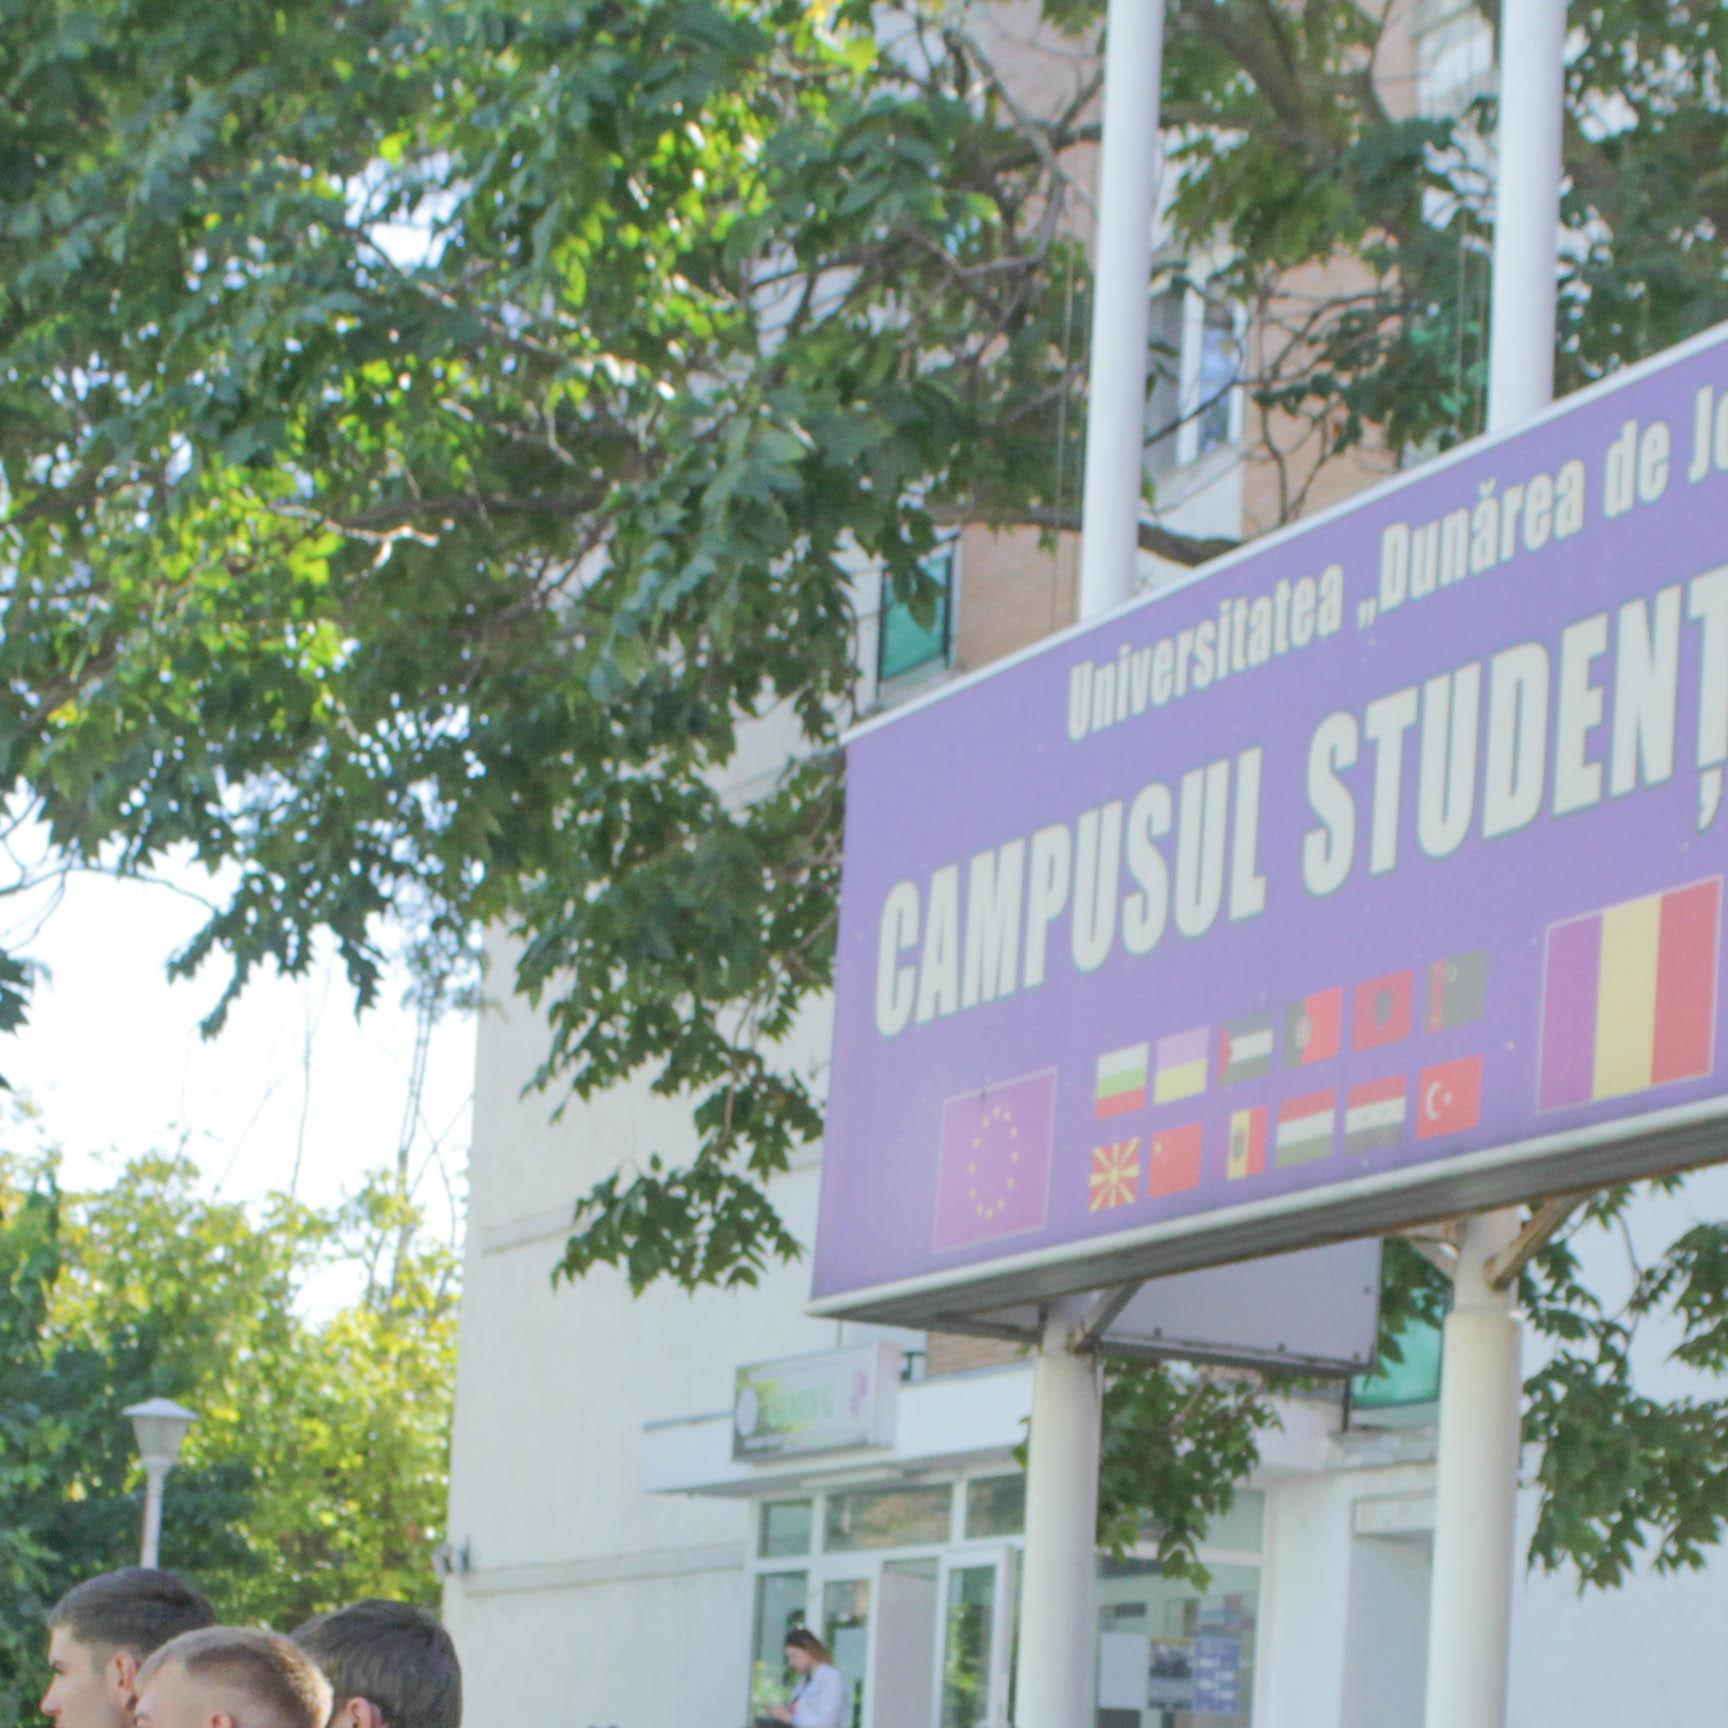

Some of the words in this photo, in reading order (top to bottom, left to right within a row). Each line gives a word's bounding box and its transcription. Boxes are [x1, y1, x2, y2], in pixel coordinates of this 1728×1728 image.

[1067, 564, 1343, 741] Universitatea
[1358, 459, 1585, 631] „Dunărea
[1604, 418, 1670, 519] de
[876, 747, 1266, 1037] CAMPUSUL
